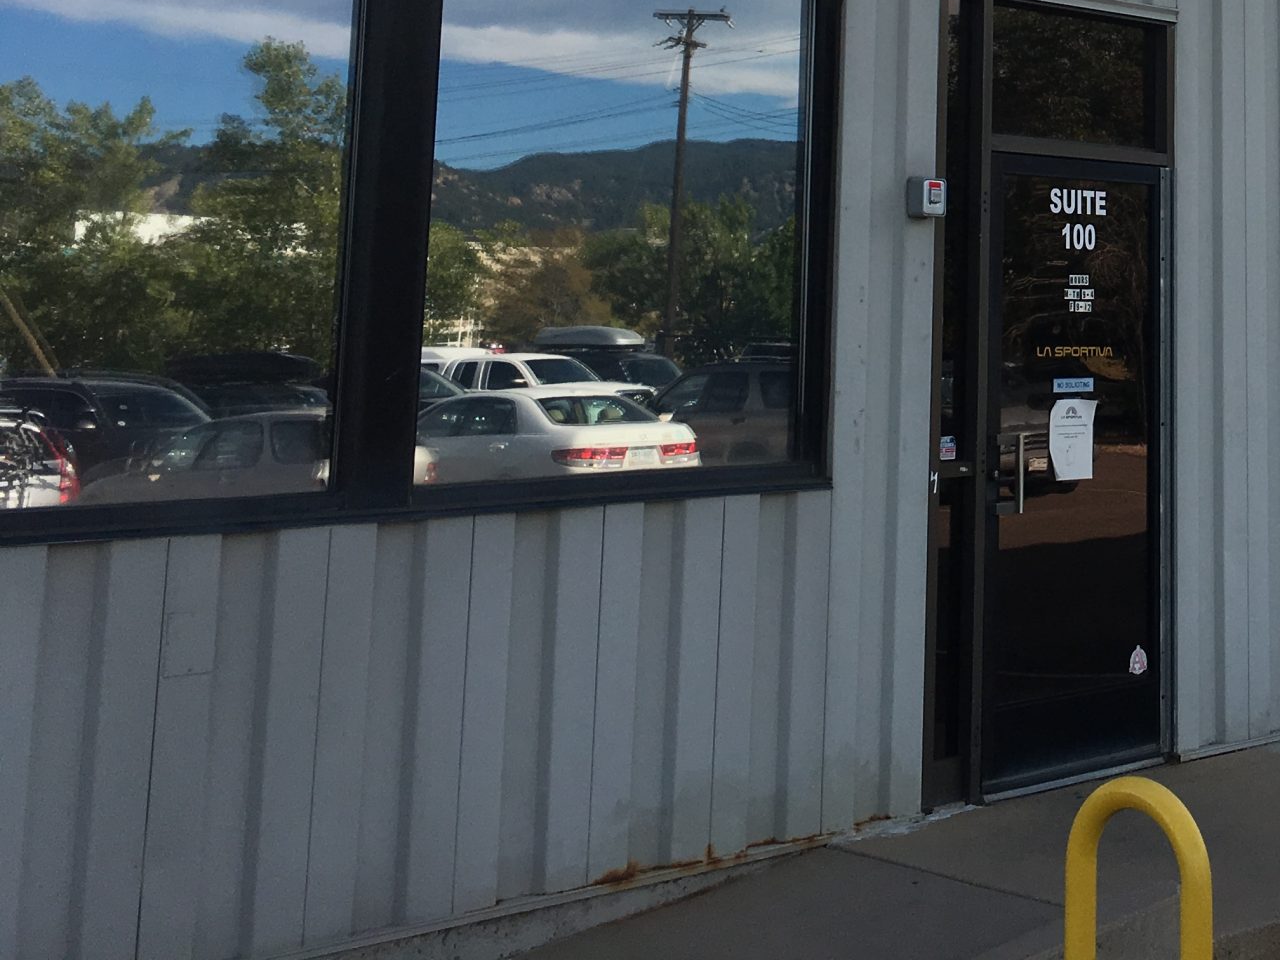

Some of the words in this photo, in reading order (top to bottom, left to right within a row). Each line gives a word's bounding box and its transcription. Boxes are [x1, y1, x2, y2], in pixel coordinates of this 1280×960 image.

[1049, 187, 1107, 216] SUITE
[1061, 223, 1096, 250] 100
[1069, 275, 1089, 285] HOURS
[1036, 346, 1052, 357] LA
[1054, 346, 1113, 357] SPORTIVA
